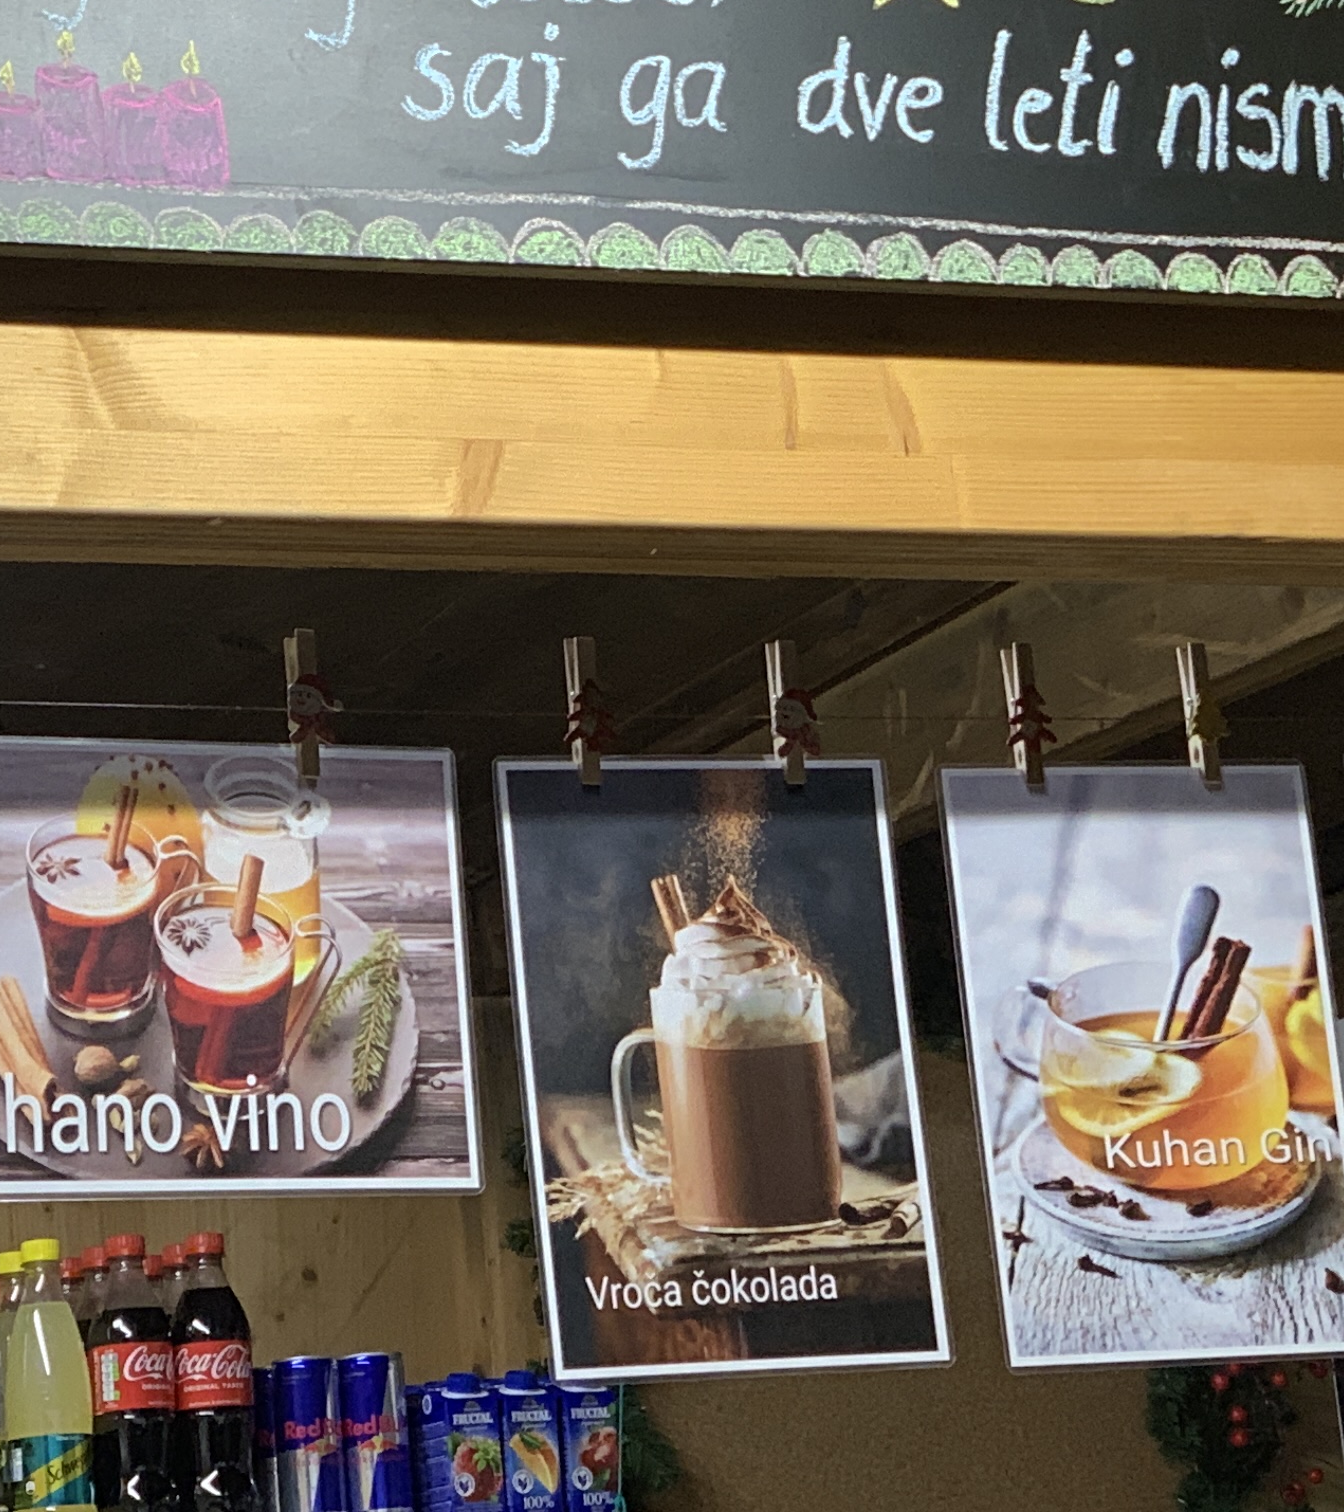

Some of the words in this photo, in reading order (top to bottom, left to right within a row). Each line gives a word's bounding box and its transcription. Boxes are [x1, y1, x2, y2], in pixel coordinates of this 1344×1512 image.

[401, 23, 564, 156] saj
[618, 53, 726, 170] ga
[797, 38, 944, 145] dve
[986, 30, 1136, 157] leti
[206, 1074, 353, 1152] vino
[1104, 1128, 1247, 1169] Kuhan
[1260, 1128, 1334, 1164] Gin
[584, 1274, 683, 1314] Vroča
[691, 1265, 838, 1306] čokolada
[453, 1412, 494, 1425] FRUCTAL
[511, 1409, 552, 1422] FRUCTAL
[571, 1407, 611, 1419] FRUCTAL
[284, 1418, 321, 1439] Red
[524, 1495, 555, 1510] 100%
